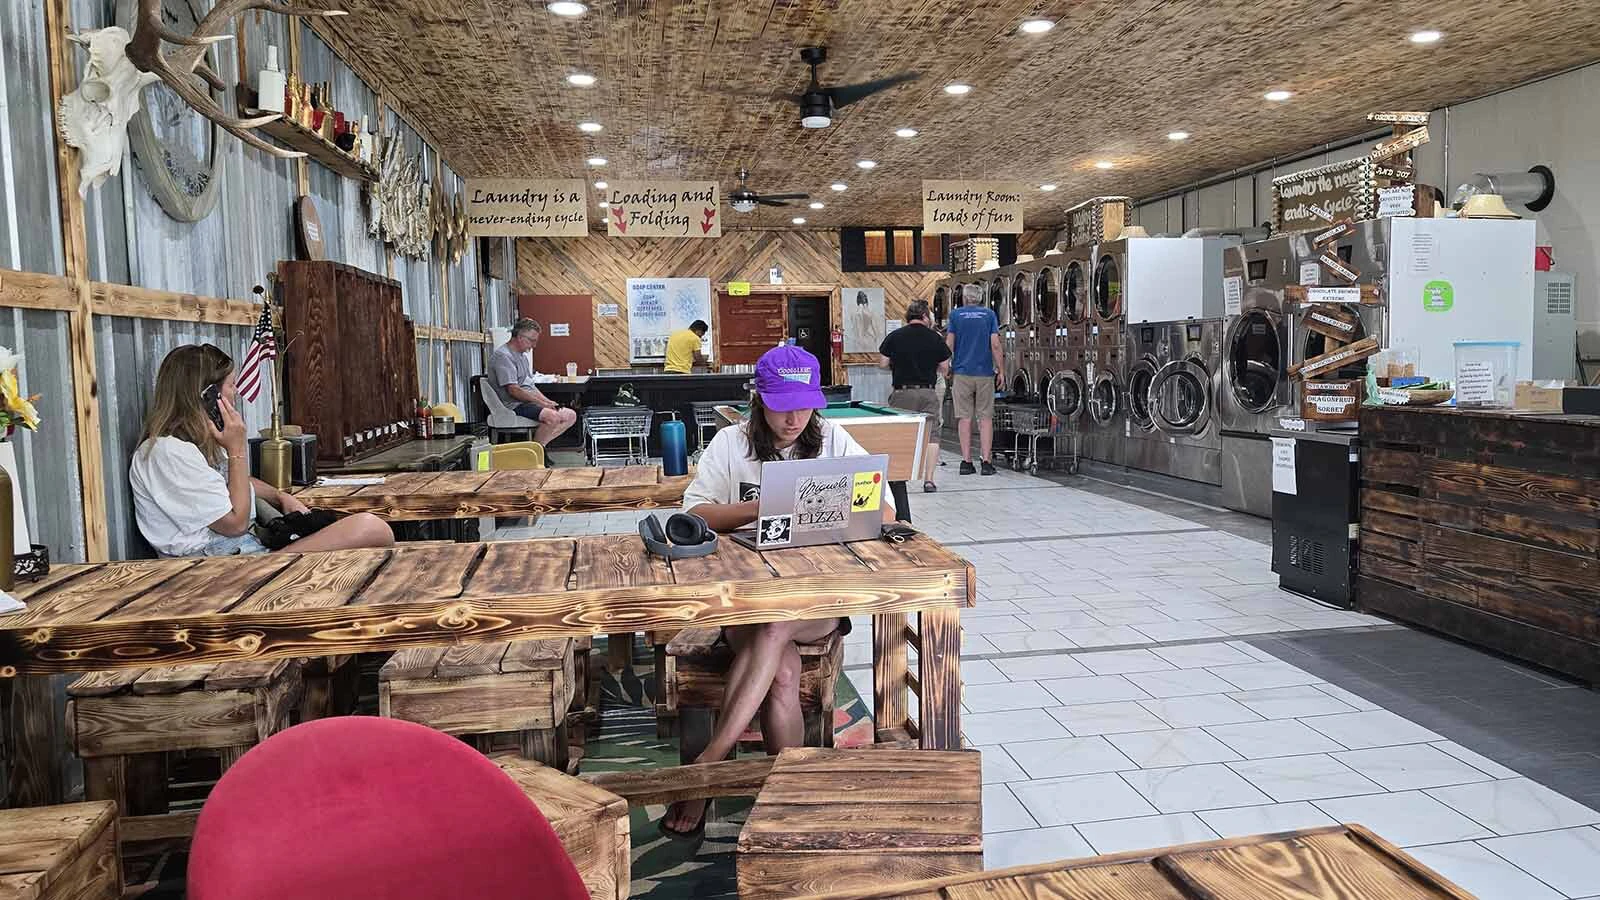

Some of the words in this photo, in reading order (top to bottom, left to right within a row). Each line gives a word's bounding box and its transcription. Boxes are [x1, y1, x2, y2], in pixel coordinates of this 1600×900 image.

[1376, 167, 1394, 176] AND
[1396, 170, 1411, 179] JOY
[471, 189, 548, 212] Laundry
[553, 188, 565, 203] is
[569, 191, 581, 203] a
[609, 188, 677, 213] Loading
[682, 186, 716, 207] and
[927, 189, 983, 208] Laundry
[985, 190, 1020, 203] Room:
[469, 212, 552, 230] never-ending
[554, 212, 584, 230] cycle
[629, 210, 690, 236] Folding
[933, 208, 968, 227] loads
[971, 208, 987, 231] of
[985, 208, 1015, 231] fun
[798, 511, 845, 525] PIZZA
